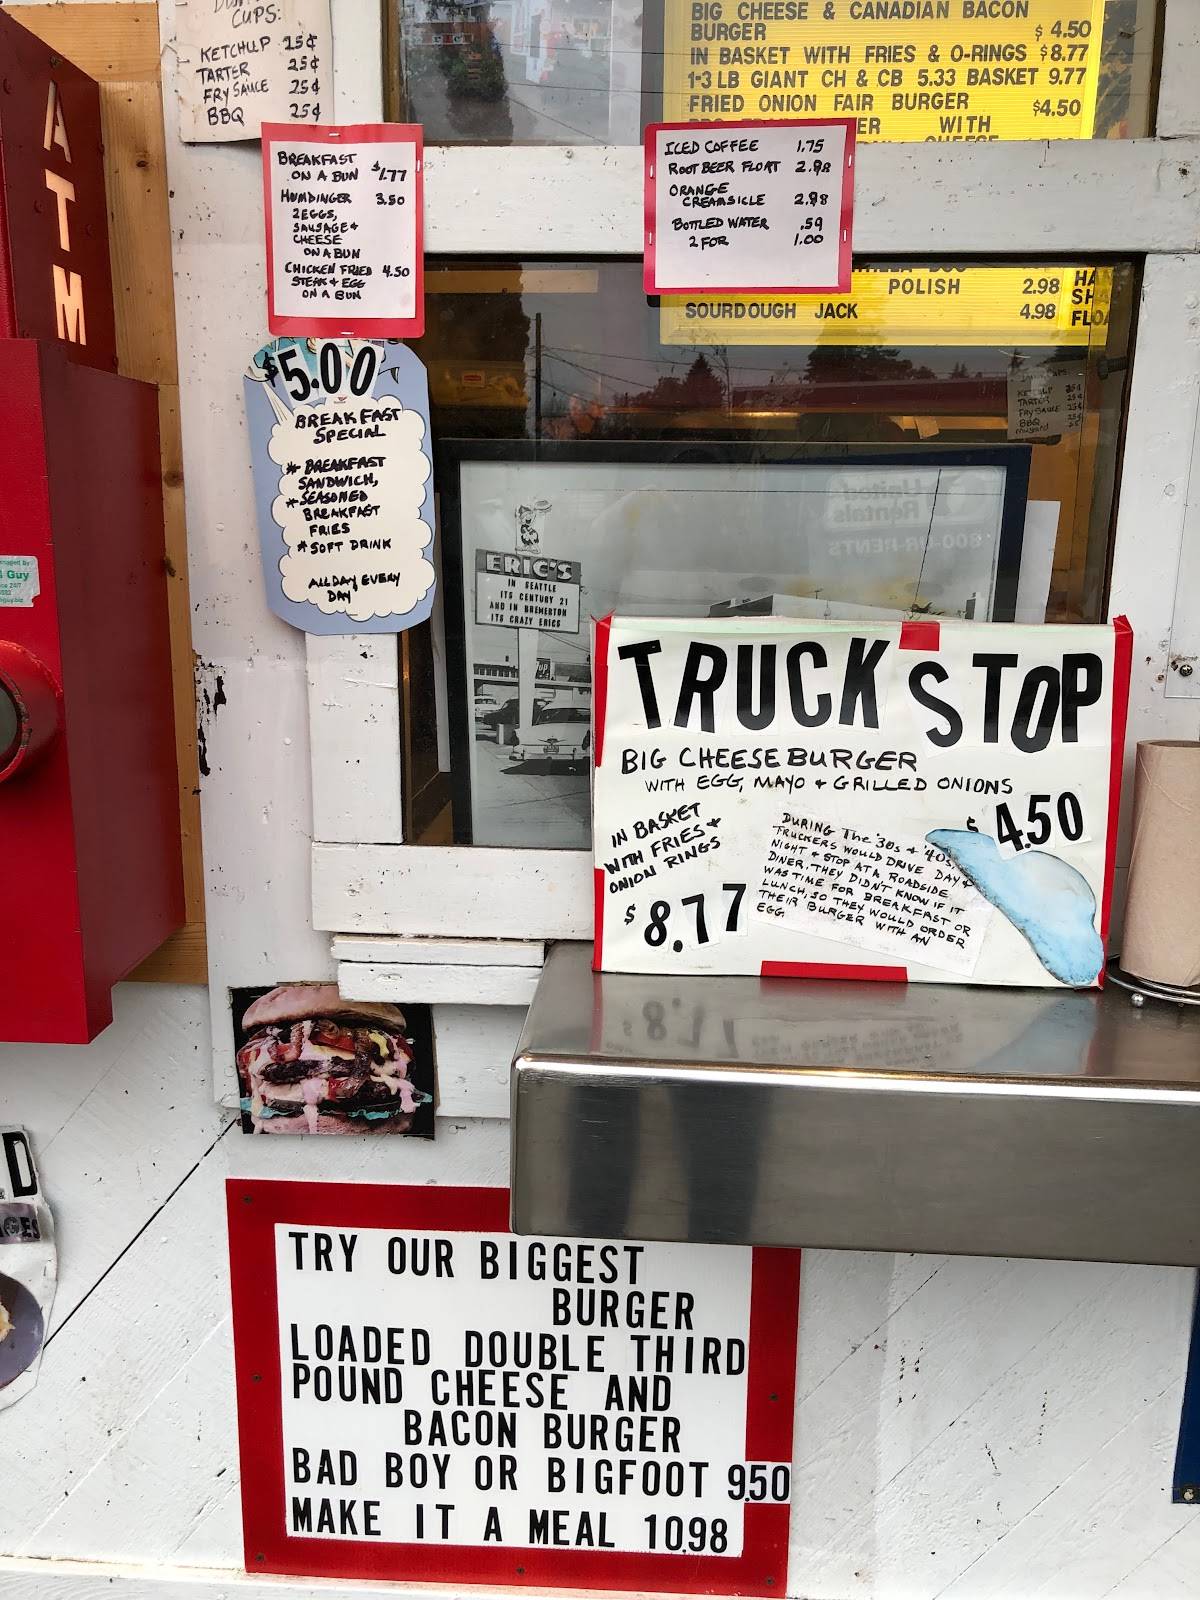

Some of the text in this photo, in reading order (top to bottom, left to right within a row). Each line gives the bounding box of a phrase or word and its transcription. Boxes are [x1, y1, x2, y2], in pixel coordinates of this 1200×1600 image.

[232, 4, 281, 28] CUPS:
[692, 0, 1029, 21] BIG CHEESE & CANADIAN BACON
[691, 22, 767, 41] BURGER
[200, 36, 270, 62] KETCHUP
[691, 44, 1027, 65] IN BASKET WITH FRIES & O-RINGS
[196, 62, 250, 84] TARTER
[718, 67, 1087, 88] LB GIANT CH CB 5.33 BASKET 9.77
[233, 79, 269, 97] SAUCE
[689, 94, 744, 113] FRIED
[759, 94, 817, 112] ONION
[834, 93, 874, 111] FAIR
[892, 93, 969, 110] BURGER
[207, 106, 245, 126] BBQ
[939, 116, 991, 133] WITH
[665, 139, 825, 155] ICED COFFEE 1.75
[278, 151, 357, 166] BREAKFAST
[669, 161, 781, 175] ROOT BEER FLOAT
[291, 168, 359, 182] ON A BUN
[281, 189, 405, 205] HUMDINGER 3.50
[669, 182, 729, 196] ORANGE
[683, 194, 765, 208] CREAMSICLE
[44, 80, 87, 346] ATM
[293, 222, 348, 233] SAUSAGE
[672, 217, 723, 231] BOTTLED
[728, 217, 769, 230] WATER
[293, 234, 343, 245] CHEESE
[794, 233, 823, 246] 1.00
[285, 262, 410, 278] CHICKEN FRIED 4.50
[291, 276, 366, 288] STEAK EGG
[888, 278, 1060, 295] POLISH 2.98
[335, 290, 361, 300] BUN
[685, 302, 1056, 320] SOURDOUGH JACK 4.98
[295, 407, 401, 429] BREAKFAST
[313, 425, 386, 444] SPECIAL
[305, 457, 386, 474] BREAKFAST
[298, 473, 379, 490] SANDWICH,
[300, 490, 368, 505] SEASONED
[303, 504, 380, 521] BREAKFAST
[309, 523, 350, 537] FRIES
[310, 538, 391, 554] SOFT DRINK
[486, 551, 572, 580] ERIC'S
[7, 570, 29, 581] Guy
[362, 573, 401, 587] EVERY
[508, 578, 557, 592] IN SEATTLE
[327, 590, 351, 603] DAY
[500, 590, 554, 604] ITS CENTURY
[489, 601, 505, 610] AND
[524, 604, 567, 617] BREMERTON
[491, 613, 561, 628] ITS CRAZY ERICS
[617, 637, 1103, 753] TRUCK STOP
[621, 748, 667, 775] BIG
[645, 778, 685, 792] WITH
[753, 775, 805, 794] MAYO
[833, 775, 927, 792] GRILLED
[937, 777, 1013, 794] ONIONS
[611, 802, 701, 848] IN BASKET
[782, 812, 836, 836] DURING
[604, 824, 706, 875] WITH FRIES
[773, 825, 961, 888] TRUCKERS WOULD DRIVE DAY
[609, 836, 721, 894] ONION RINGS
[771, 839, 949, 898] NIGHT STOP ROADSIDE
[810, 863, 966, 915] THEY DIDN'T KNOW IF IT
[764, 866, 971, 937] WAS TIME FOR BREAKFAST OR
[759, 889, 931, 946] THEIR BURGER WITH AN
[833, 897, 965, 949] THEY WOULD ORDER
[288, 1231, 644, 1285] TRY OUR BIGGEST
[552, 1287, 695, 1330] BURGER
[290, 1323, 745, 1376] LOADED DOUBLE THIRD
[292, 1362, 671, 1412] POUND CHEESE AND
[404, 1409, 681, 1453] BACON BURGER
[292, 1447, 790, 1502] BAD BOY OR BIGFOOT 9.50
[292, 1497, 728, 1554] MAKE IT A MEAL 10.98
